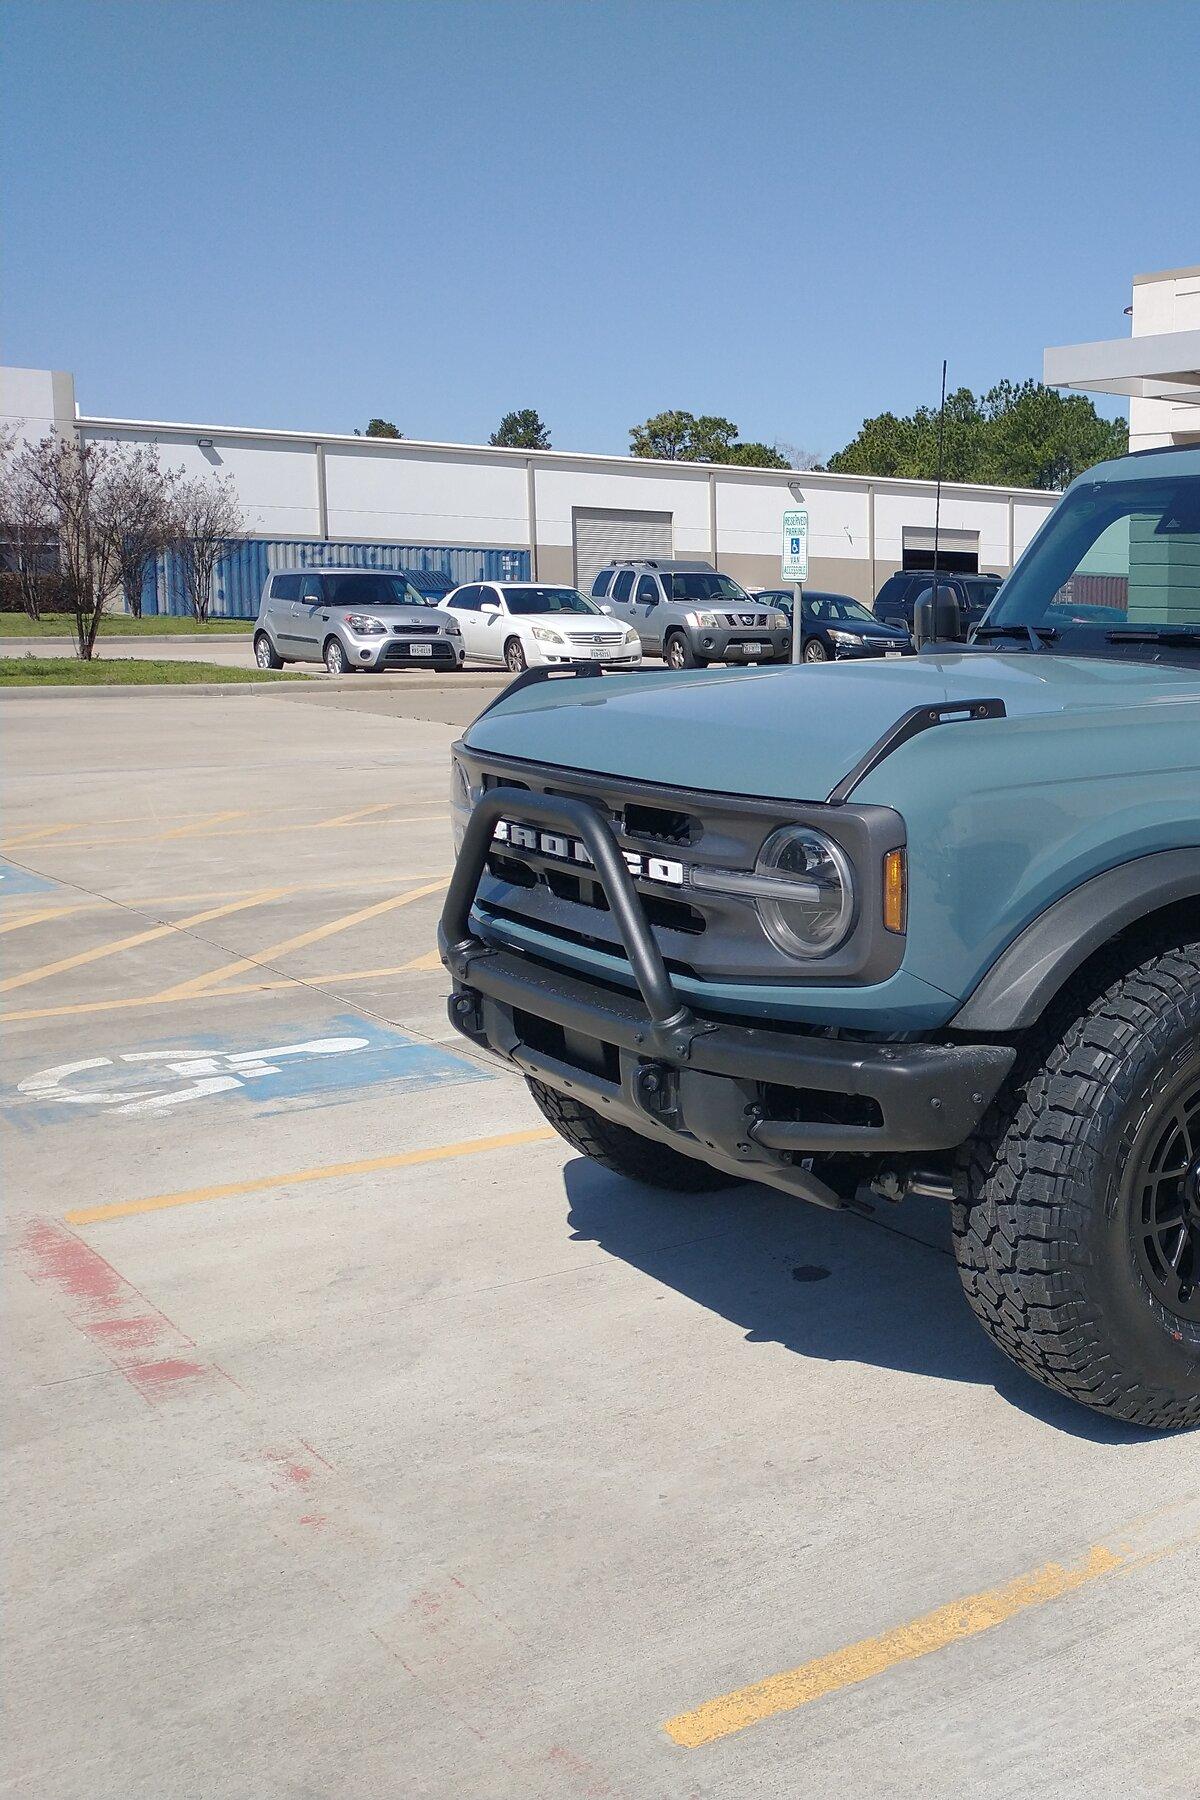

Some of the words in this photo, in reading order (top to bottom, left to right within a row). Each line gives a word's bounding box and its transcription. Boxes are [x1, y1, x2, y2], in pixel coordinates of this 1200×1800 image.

[785, 516, 807, 526] RESERVED
[786, 527, 805, 536] PARKING
[791, 556, 800, 564] VAN
[785, 565, 806, 575] ACCESSIBLE
